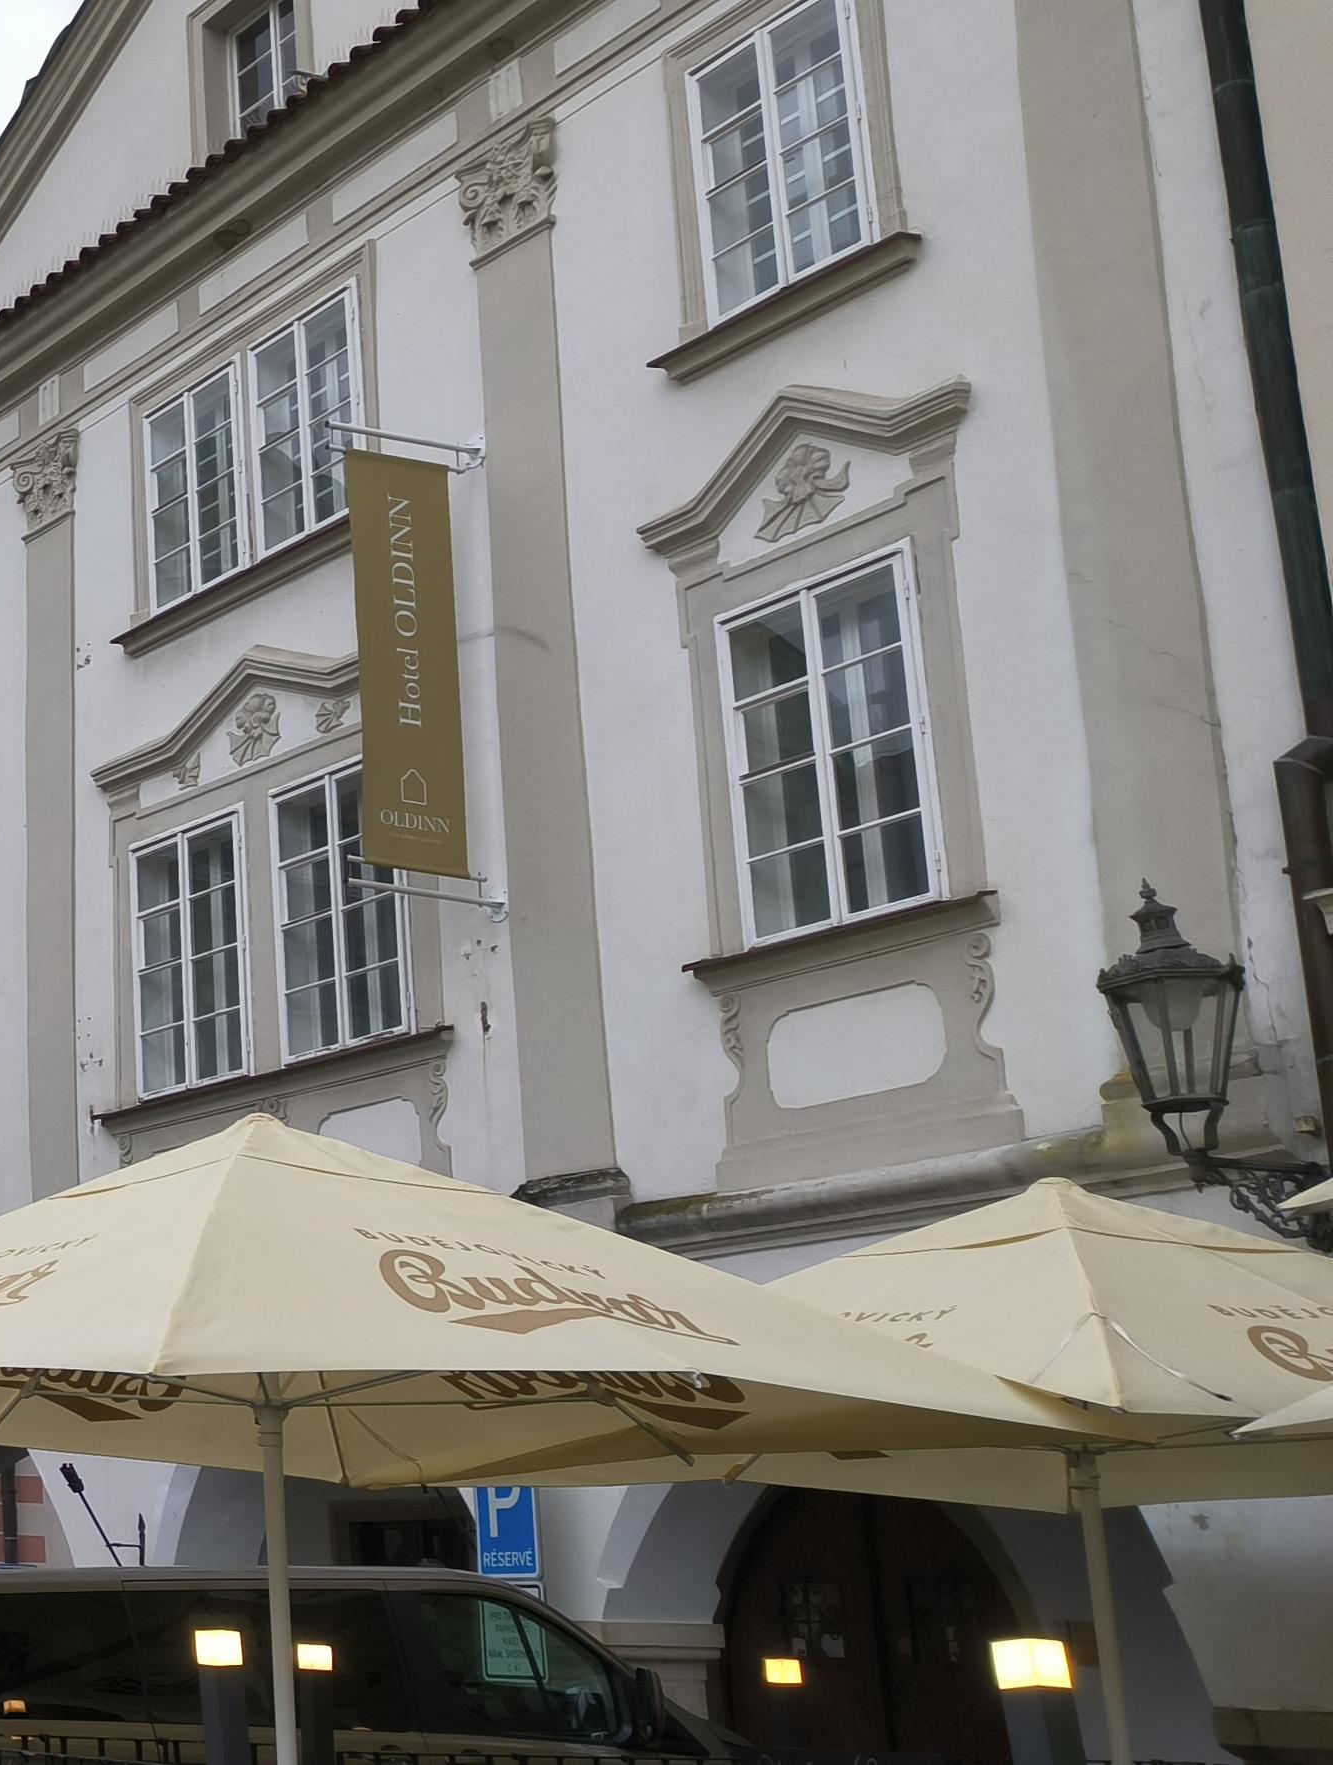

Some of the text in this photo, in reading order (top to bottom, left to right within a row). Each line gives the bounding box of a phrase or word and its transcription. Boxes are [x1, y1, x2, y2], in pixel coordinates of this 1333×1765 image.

[388, 494, 423, 730] Hotel OLDINN
[380, 808, 451, 834] OLDINN
[378, 1248, 742, 1347] Budvar
[487, 1487, 520, 1537] P
